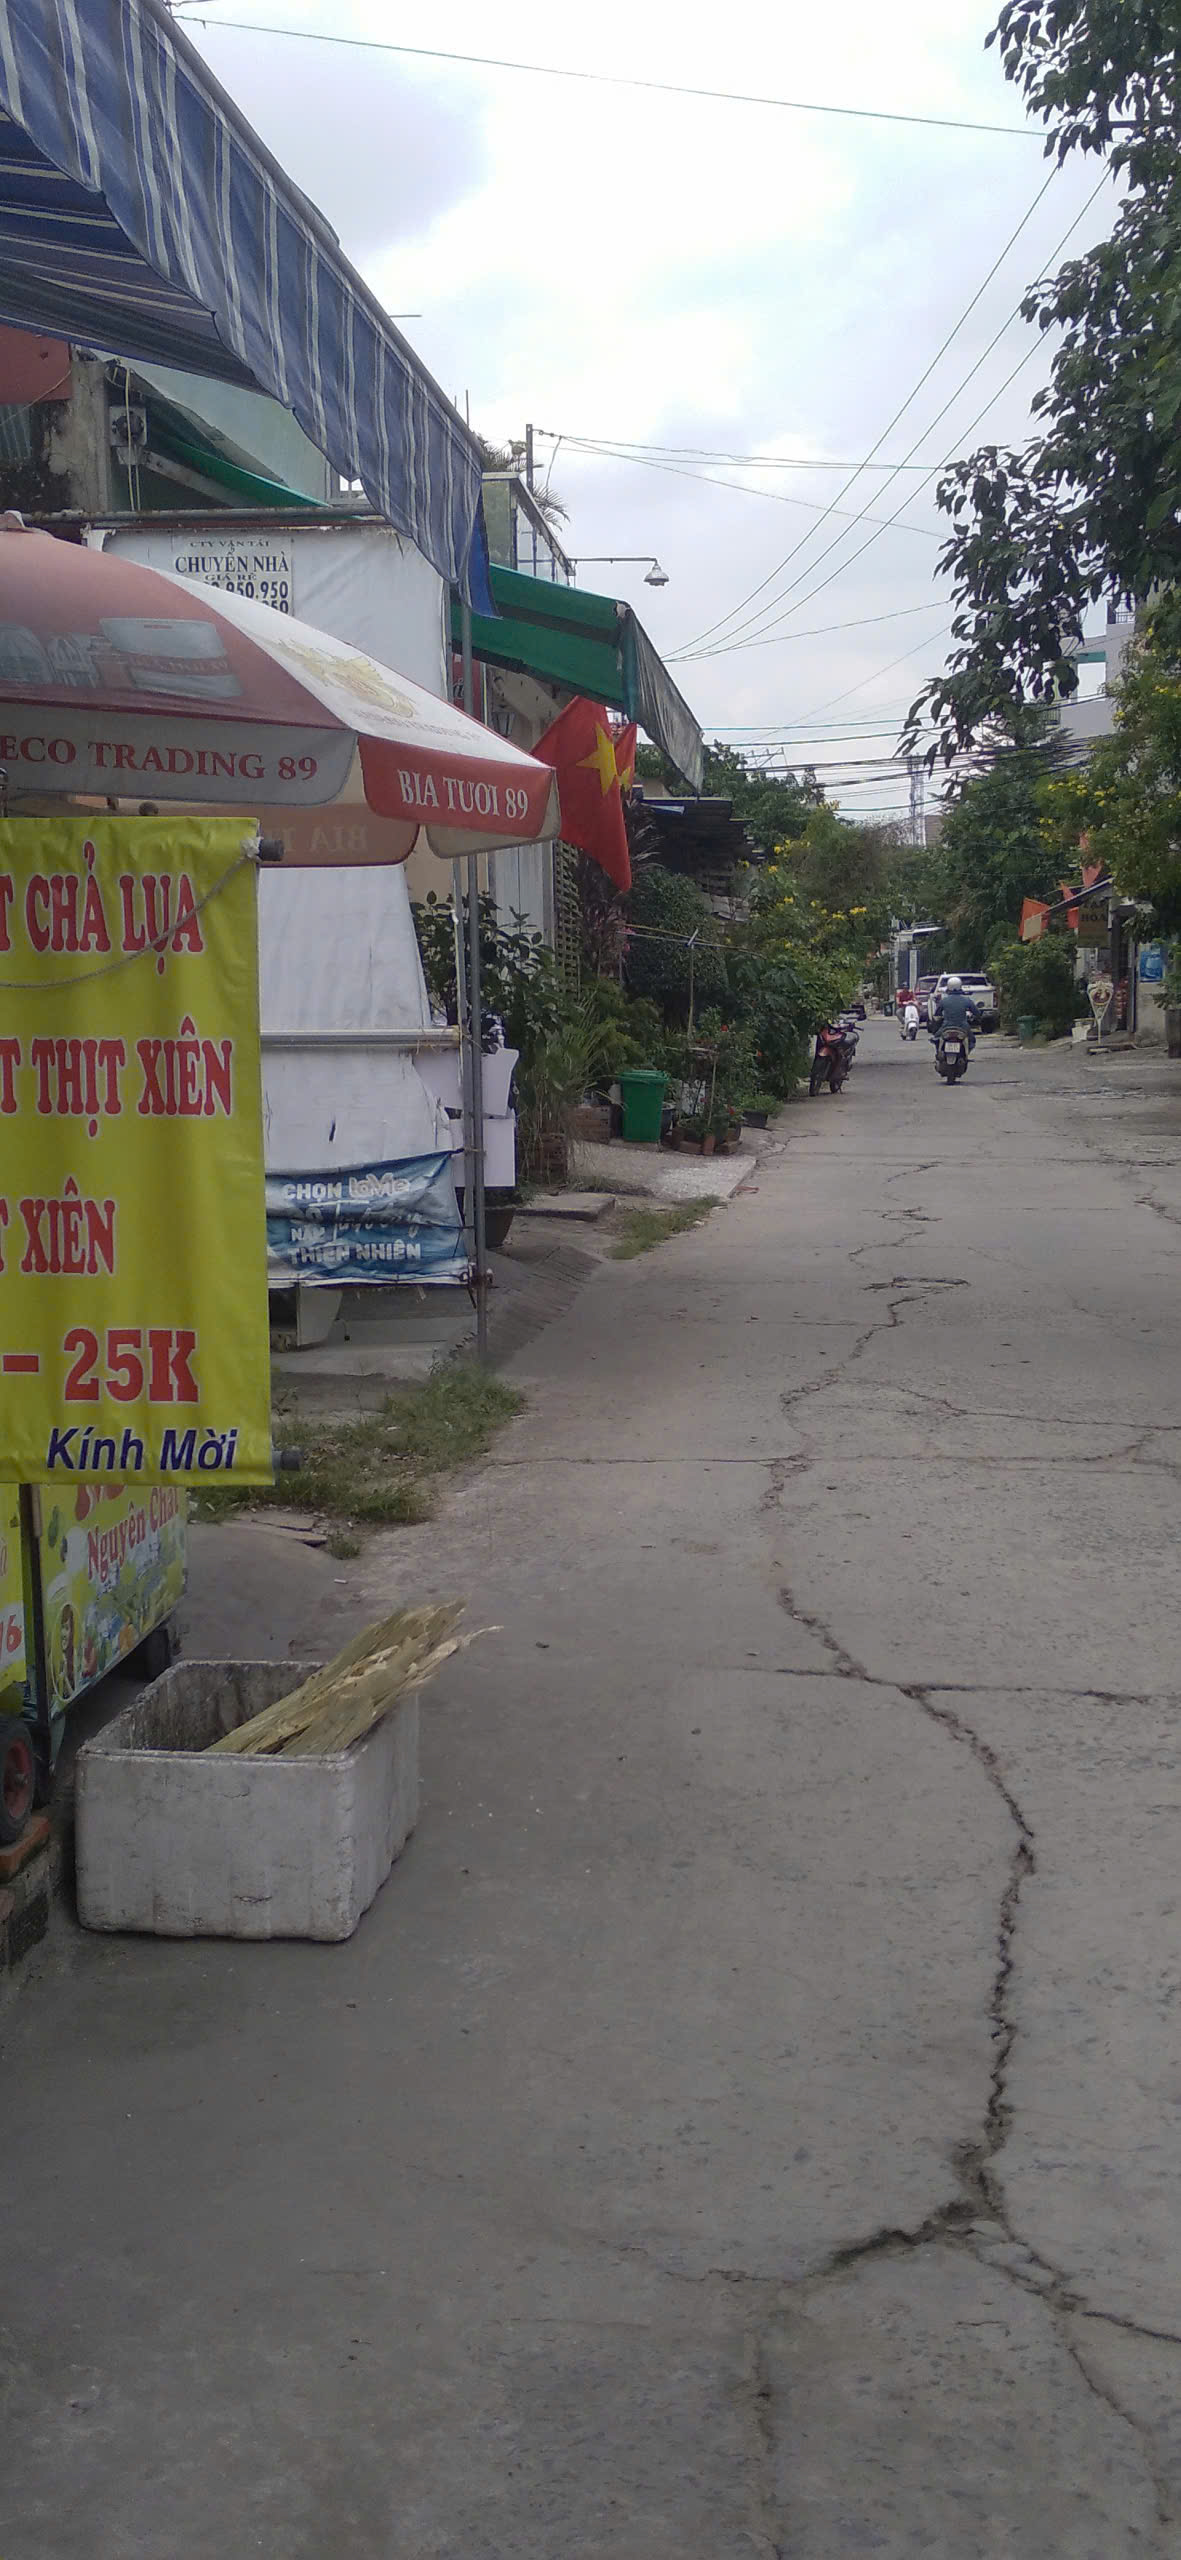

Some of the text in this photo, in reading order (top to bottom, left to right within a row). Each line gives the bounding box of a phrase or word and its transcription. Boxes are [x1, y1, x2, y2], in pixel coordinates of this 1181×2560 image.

[175, 547, 289, 573] CHUYỂN NHÀ
[88, 741, 266, 780] TRADING
[278, 756, 318, 781] 89
[398, 769, 440, 809] BIA
[505, 788, 529, 820] 89
[26, 841, 111, 952] CHẢ
[119, 874, 204, 975] LỤA
[32, 1038, 125, 1137] THỊT
[137, 1016, 232, 1115] XIÊN
[285, 1182, 342, 1202] CHỌN
[20, 1176, 115, 1274] XIÊN
[356, 1239, 421, 1261] NHIÊN
[64, 1328, 198, 1402] 25K
[47, 1426, 237, 1471] Kính Mời
[88, 1501, 145, 1583] Nguyên
